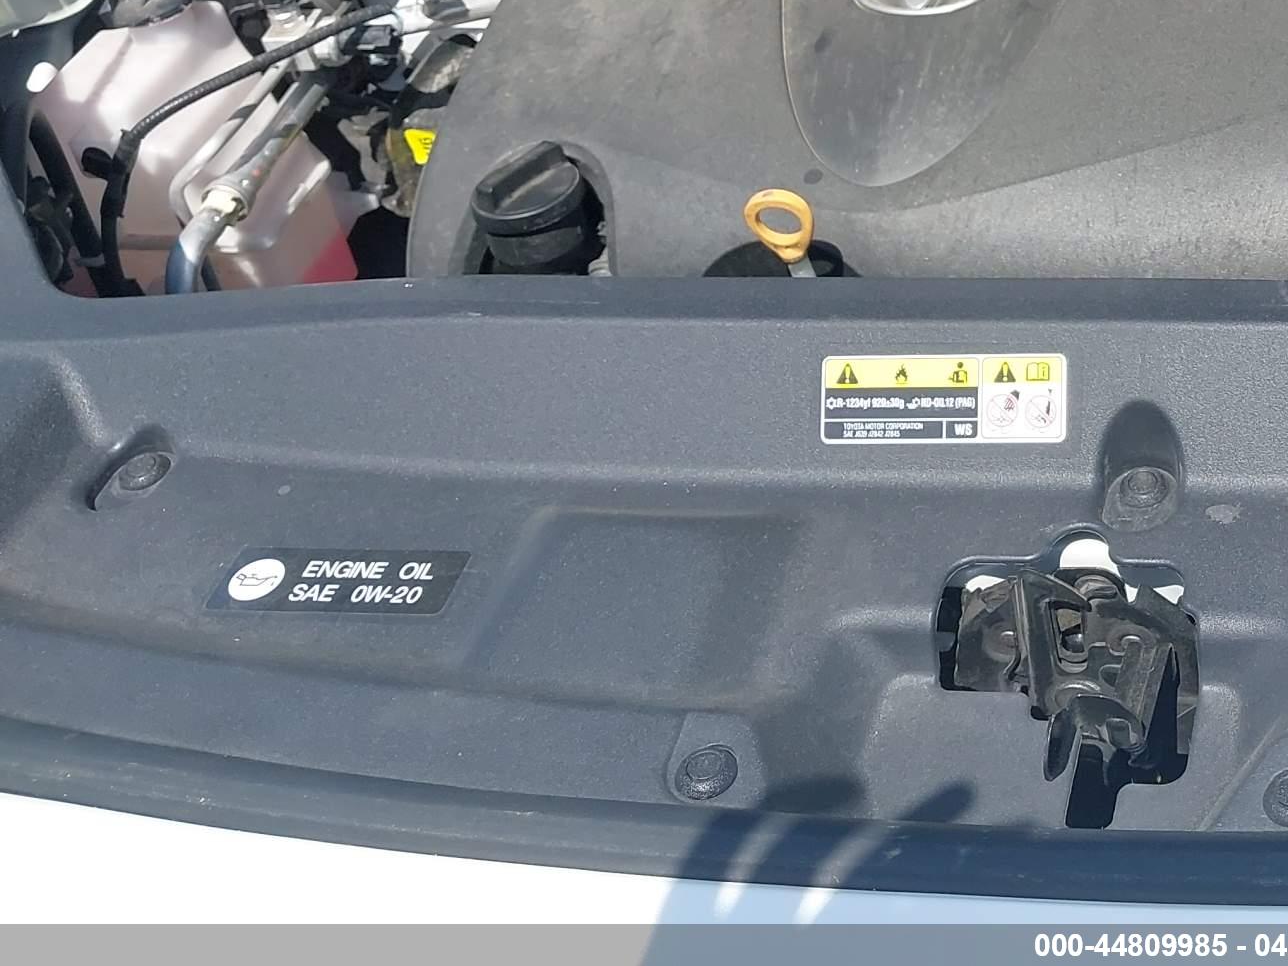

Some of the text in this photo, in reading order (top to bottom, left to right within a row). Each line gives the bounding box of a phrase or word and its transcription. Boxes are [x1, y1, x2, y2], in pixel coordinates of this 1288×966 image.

[843, 422, 924, 430] TOYOTA MOTOR CORPORATION
[954, 422, 973, 436] WS
[302, 561, 434, 580] ENGINE OIL
[288, 584, 423, 604] SAE 0W-20
